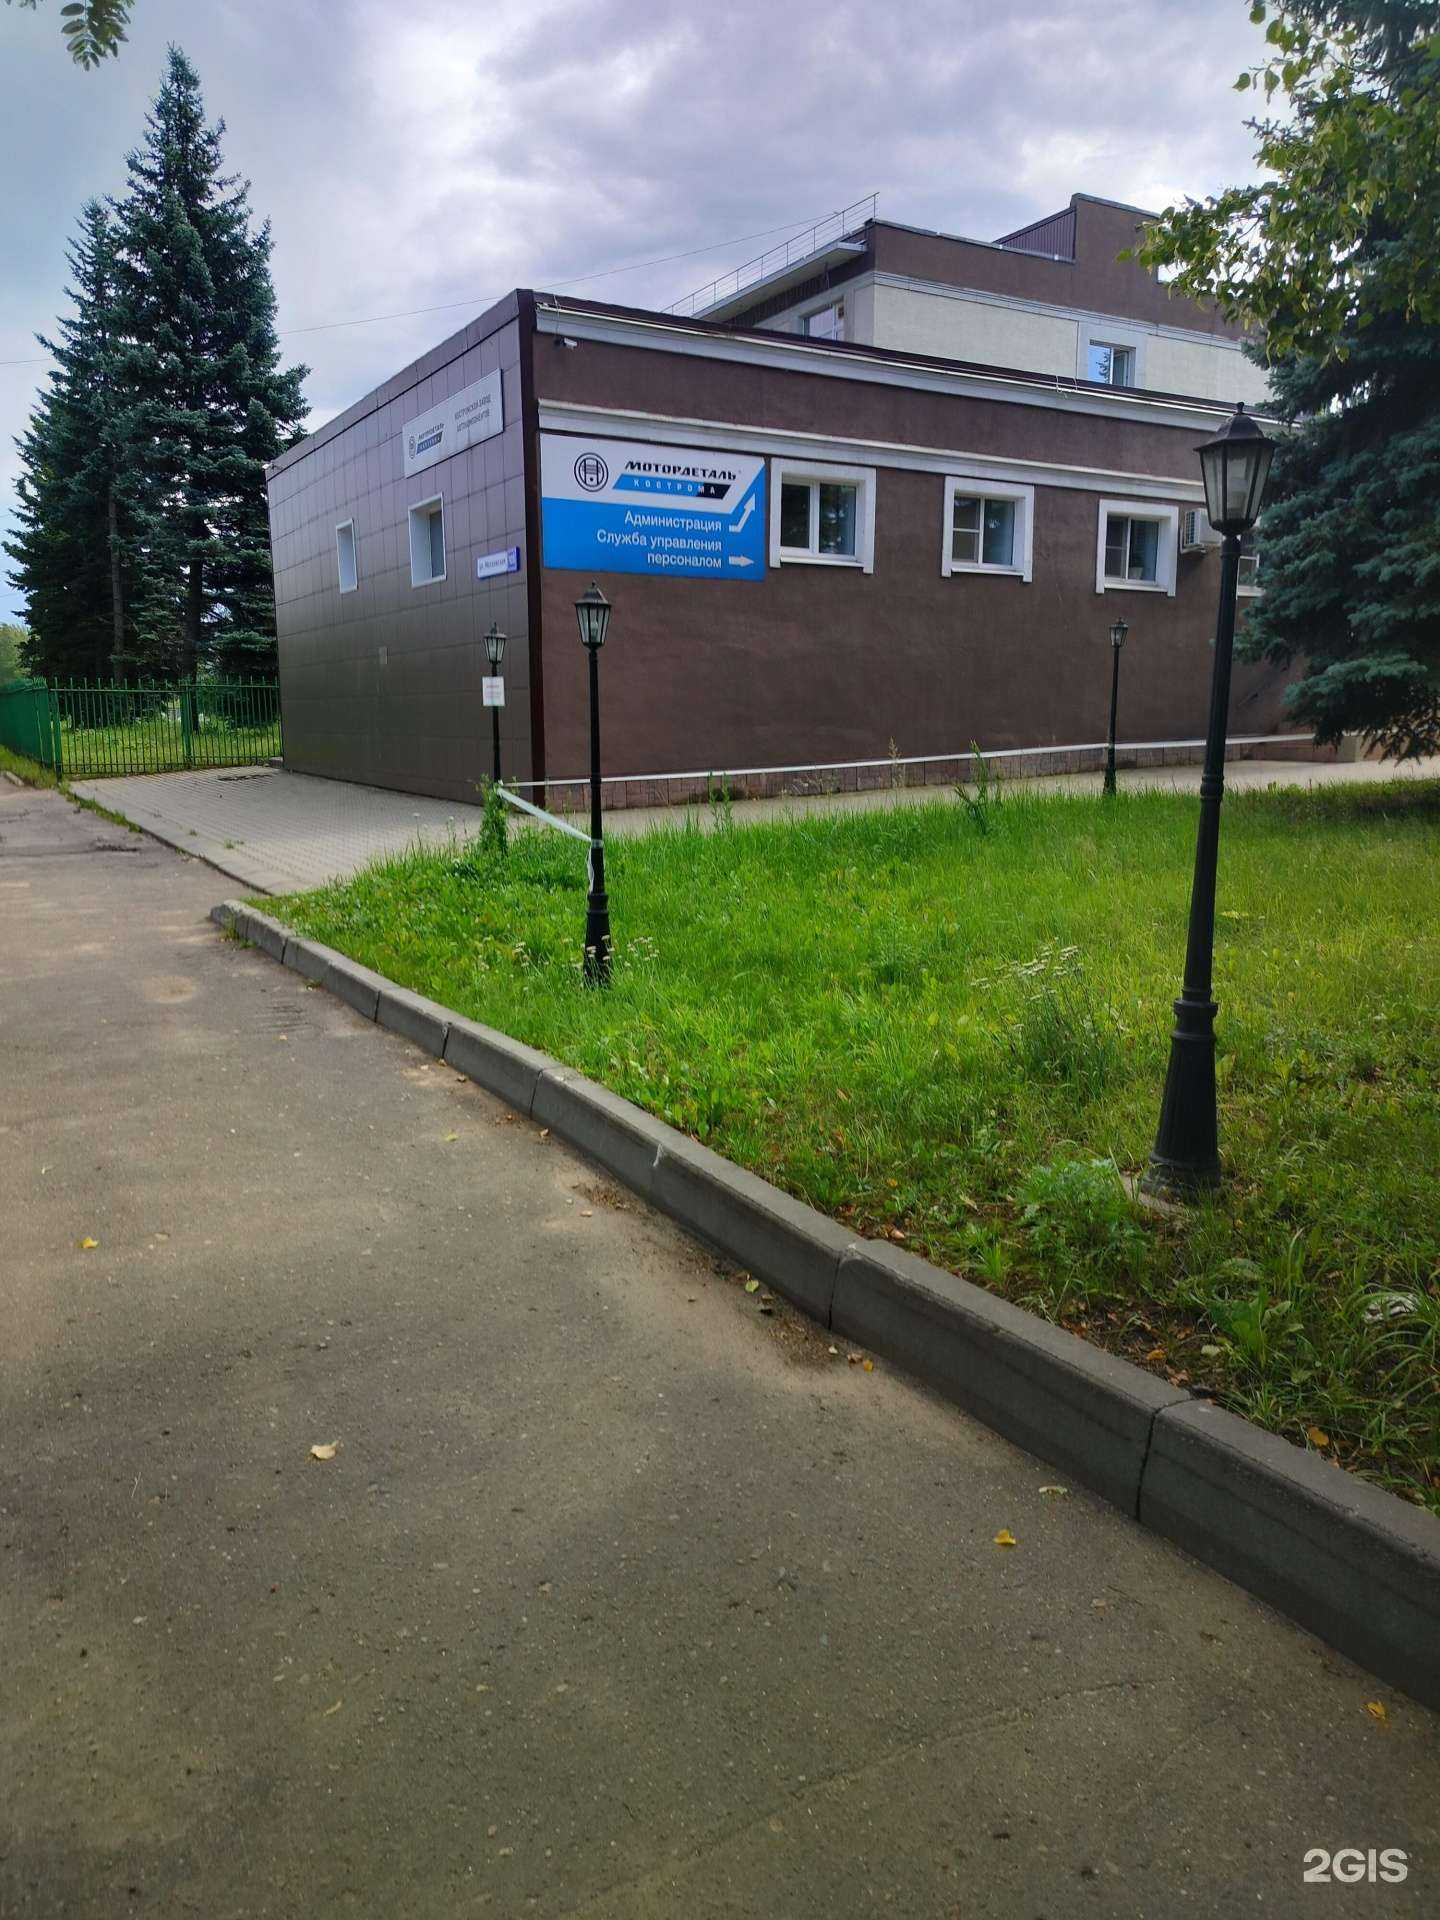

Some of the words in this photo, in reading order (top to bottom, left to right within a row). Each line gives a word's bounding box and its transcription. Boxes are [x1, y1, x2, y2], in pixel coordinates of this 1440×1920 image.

[625, 460, 737, 481] МОТОРДЕТАЛЬ
[633, 479, 716, 495] КОСТРОМА
[624, 510, 722, 532] Администрация
[597, 529, 647, 547] Служба
[650, 535, 722, 551] управления
[647, 552, 722, 568] персоналом
